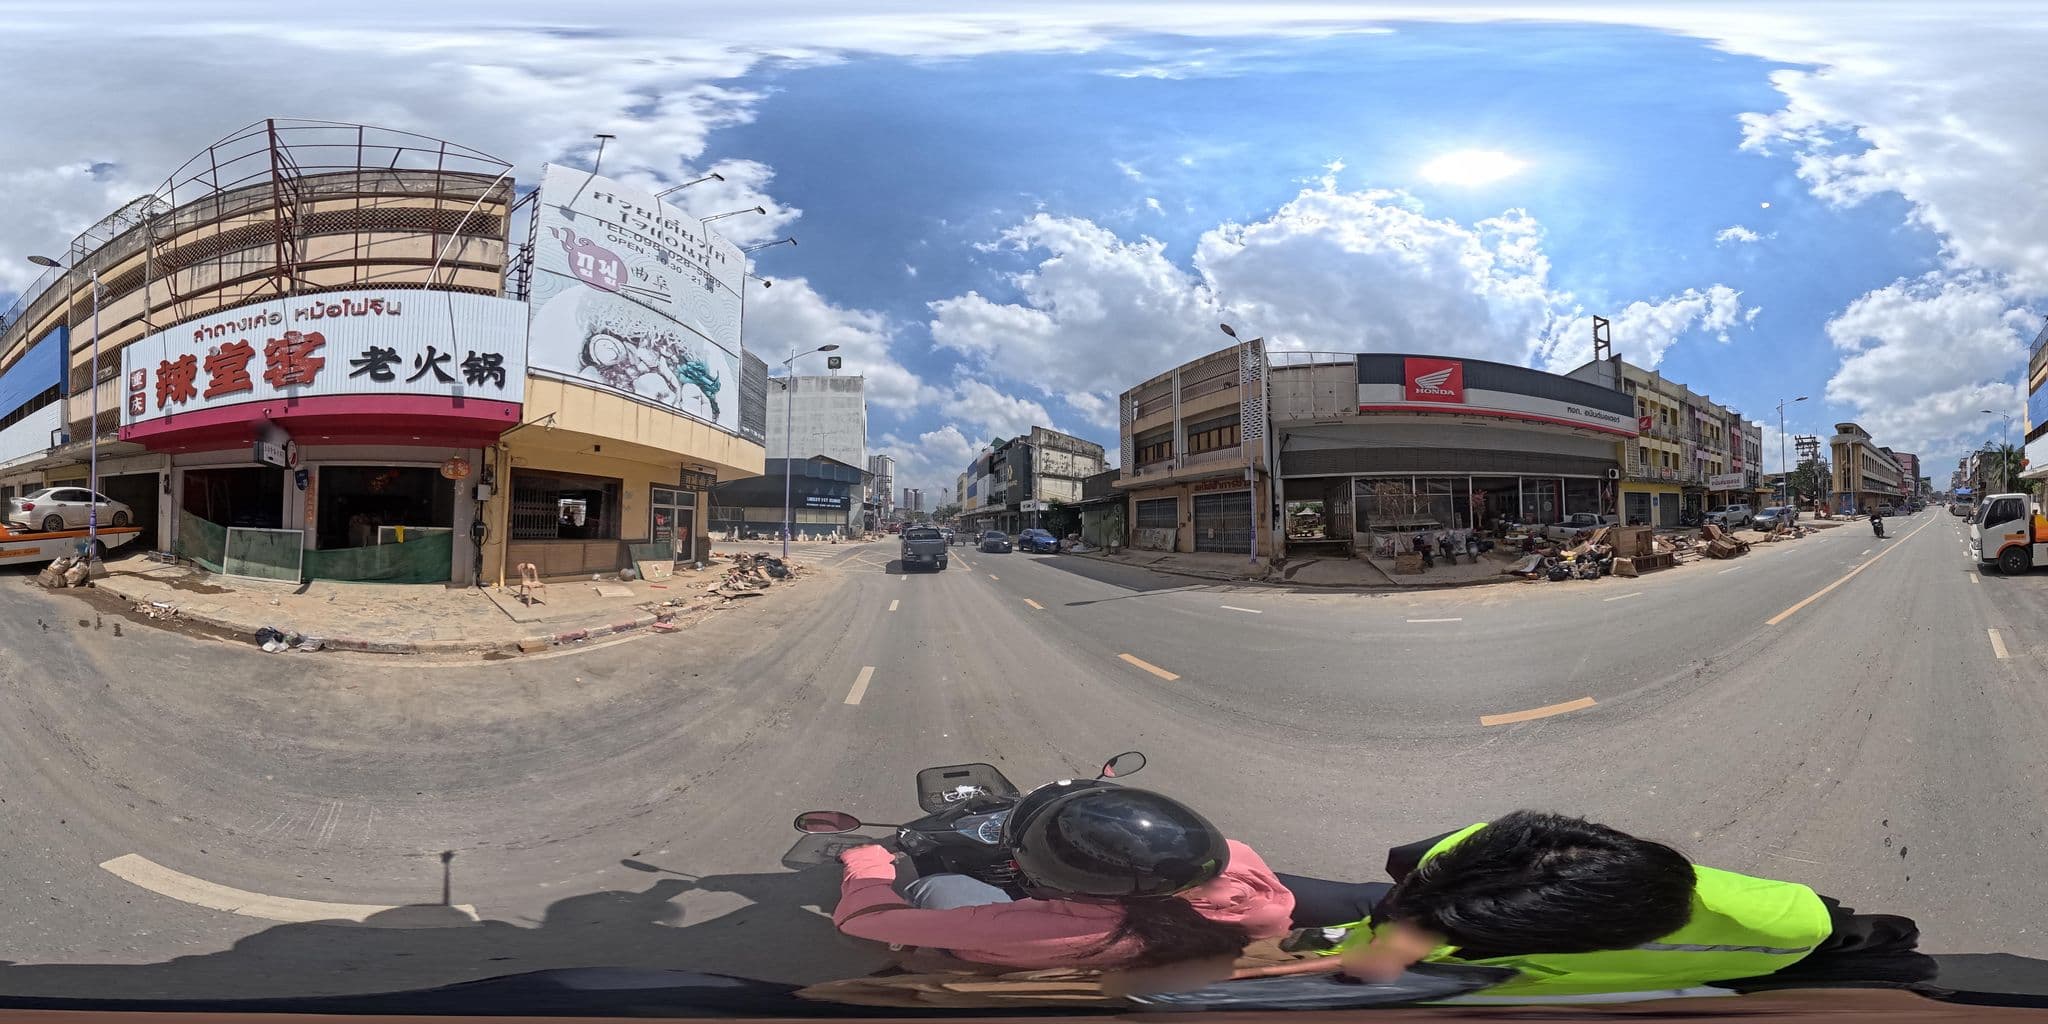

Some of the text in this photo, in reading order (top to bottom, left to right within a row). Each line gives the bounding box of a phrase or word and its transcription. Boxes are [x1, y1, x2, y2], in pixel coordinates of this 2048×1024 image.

[607, 234, 644, 254] OPEN
[294, 298, 402, 322] หม้อไฟจีน
[156, 331, 507, 409] 辣堂客 老火锅
[1415, 387, 1455, 396] HONDA
